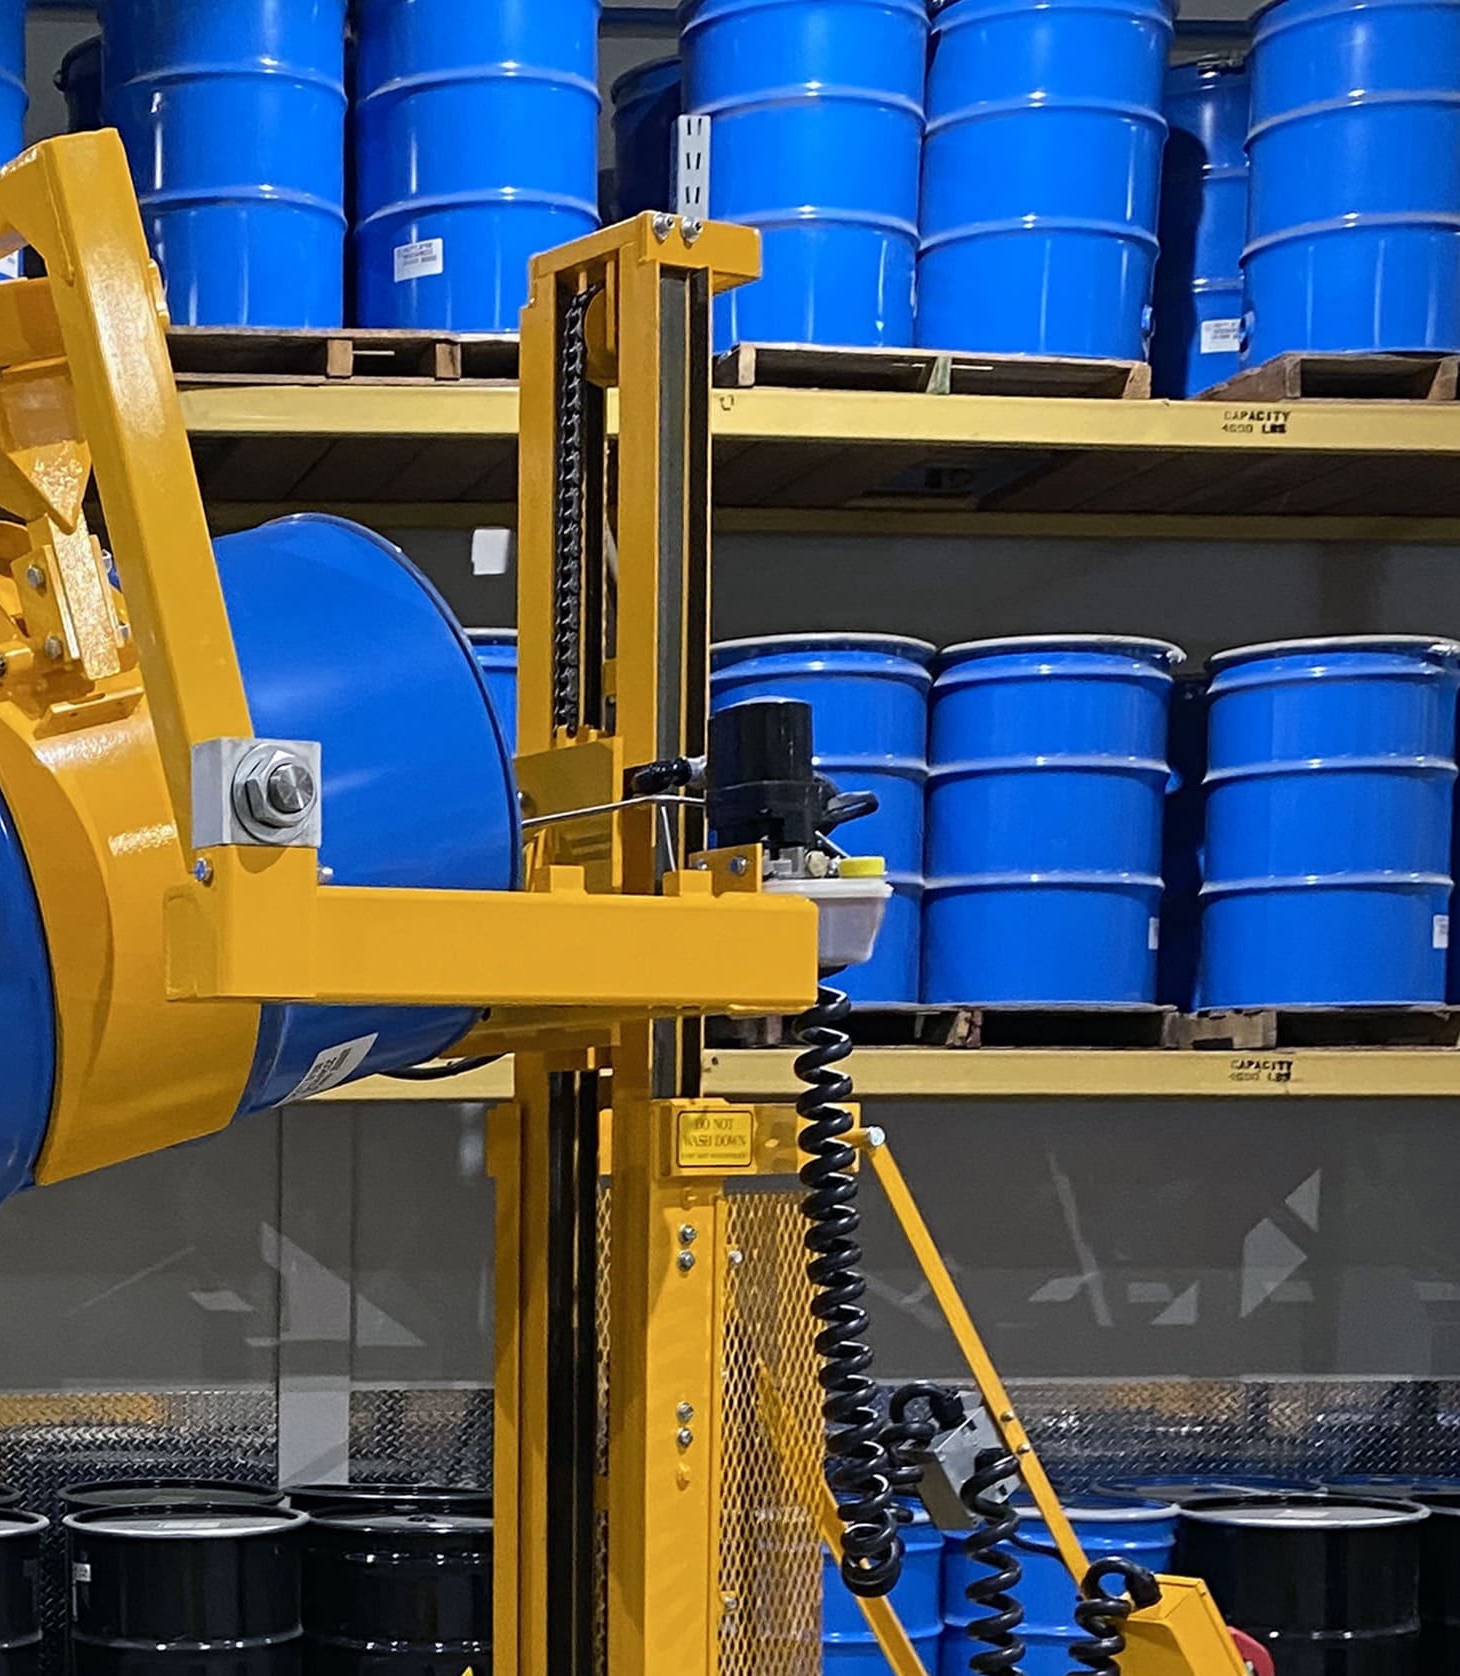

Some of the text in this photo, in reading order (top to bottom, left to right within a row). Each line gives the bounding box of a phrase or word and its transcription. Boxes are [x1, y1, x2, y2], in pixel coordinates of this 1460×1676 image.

[1224, 410, 1292, 422] CAPACITY
[695, 1117, 734, 1130] DO NOT
[715, 1134, 746, 1147] DOWN
